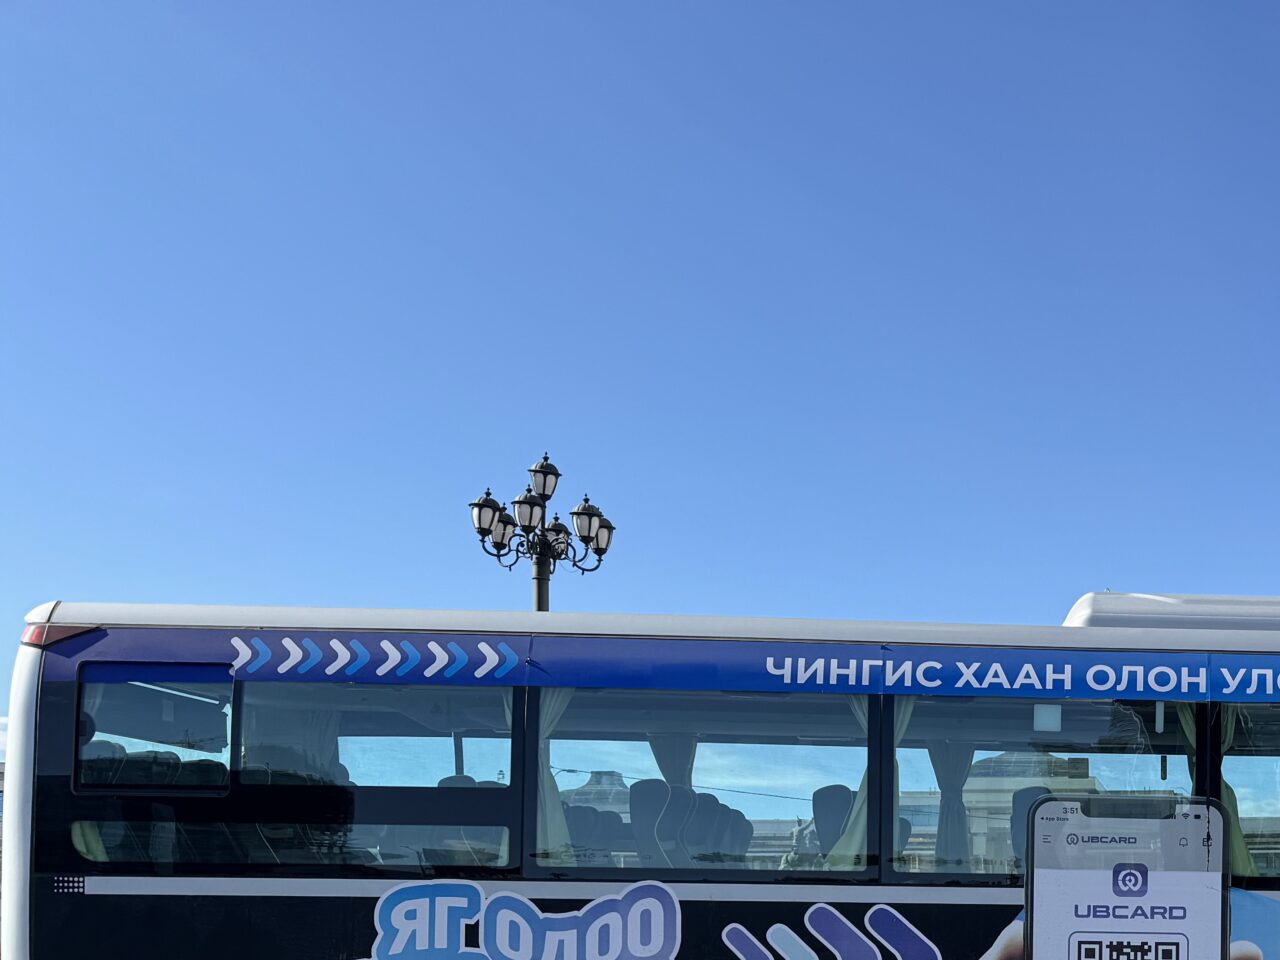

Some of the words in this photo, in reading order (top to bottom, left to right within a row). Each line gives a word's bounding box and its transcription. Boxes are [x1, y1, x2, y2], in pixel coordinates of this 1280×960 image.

[766, 656, 943, 687] ЧИНГИС
[954, 661, 1072, 691] ХААН
[1086, 663, 1207, 693] ОЛОН
[1062, 807, 1079, 815] 3:51
[1081, 835, 1138, 845] UBCARD
[1073, 904, 1188, 921] UBCARD
[388, 896, 468, 955] ЯГ
